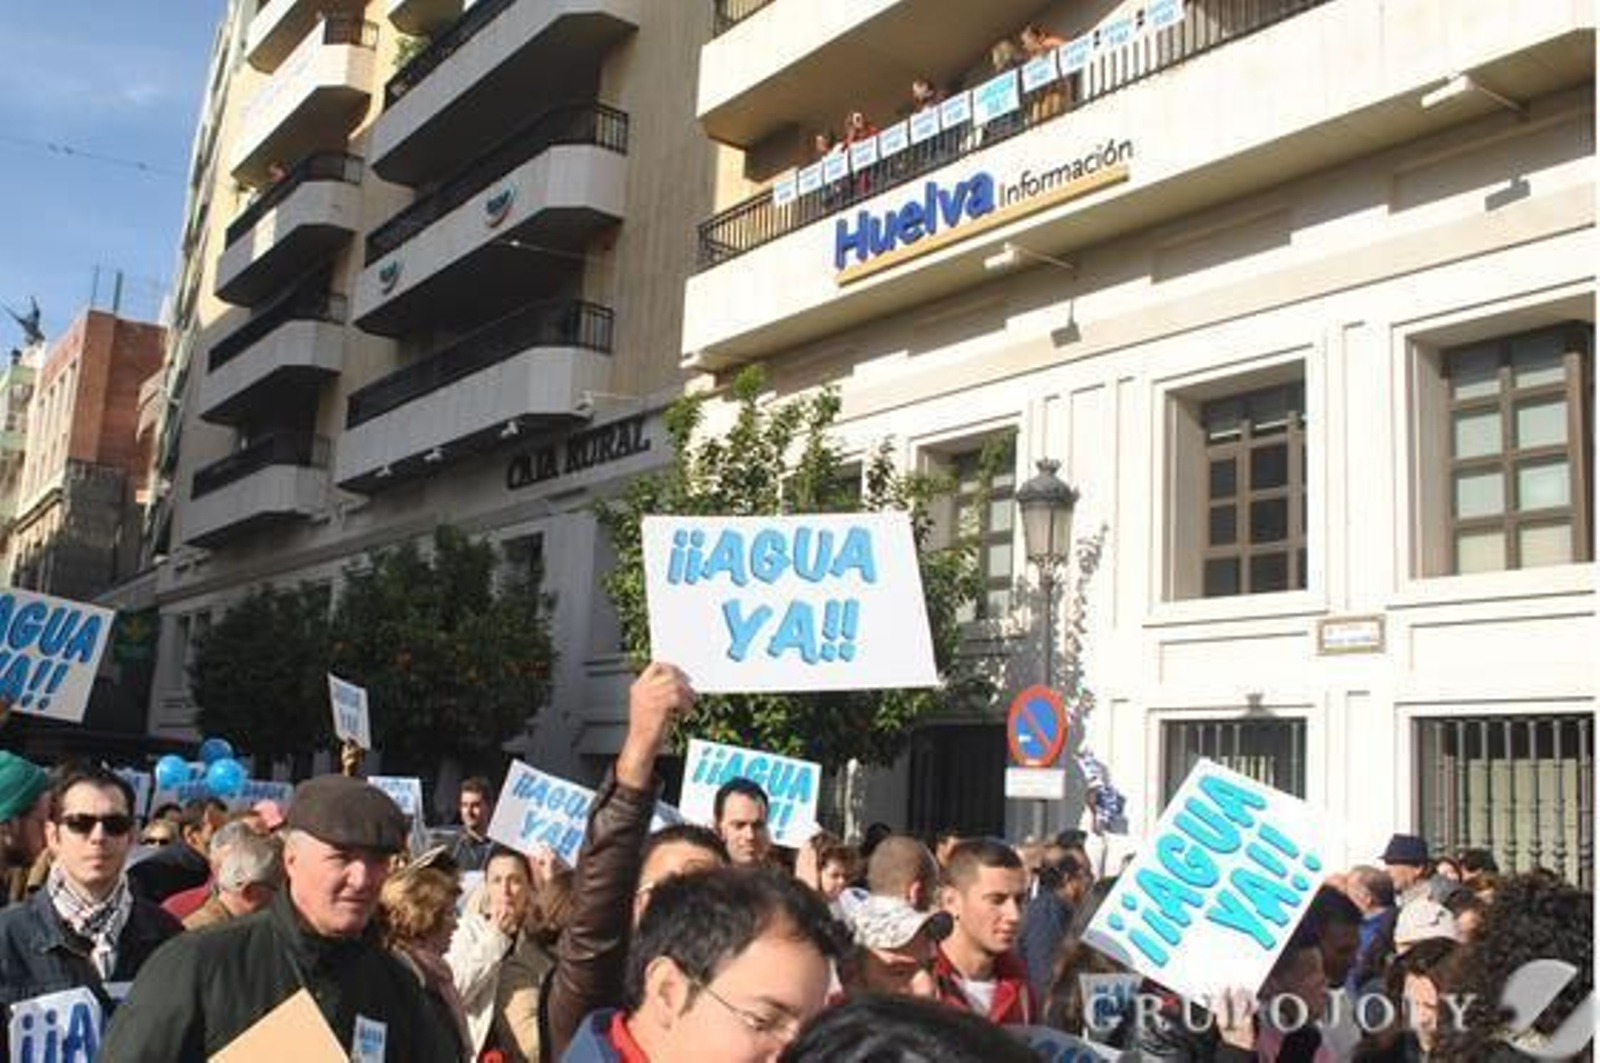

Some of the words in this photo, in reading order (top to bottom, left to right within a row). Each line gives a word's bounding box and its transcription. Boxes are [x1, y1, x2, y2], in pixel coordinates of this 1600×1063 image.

[835, 171, 996, 270] Huelva
[1000, 139, 1135, 208] Información
[565, 413, 651, 475] RURAL
[667, 527, 877, 586] ¡¡AGUA
[722, 598, 860, 665] YA!!
[0, 651, 69, 710] A!!
[512, 771, 589, 819] ¡¡AGU
[1107, 775, 1267, 968] ¡¡AGUA
[1205, 822, 1322, 950] YA!!
